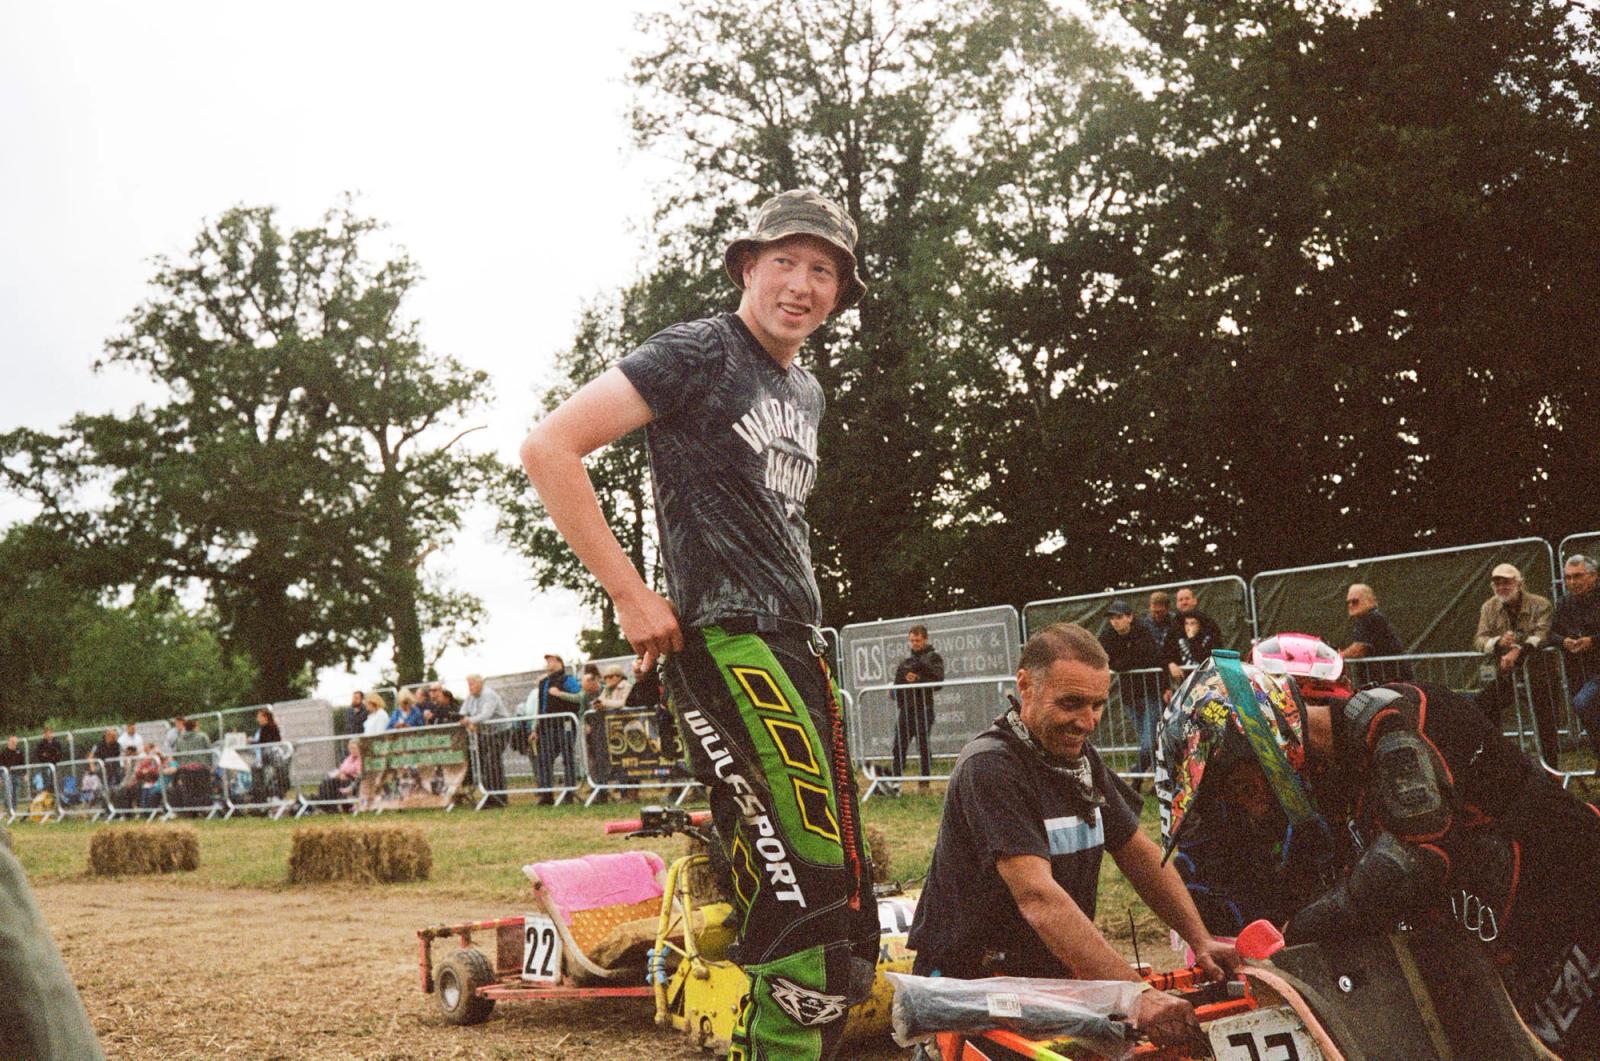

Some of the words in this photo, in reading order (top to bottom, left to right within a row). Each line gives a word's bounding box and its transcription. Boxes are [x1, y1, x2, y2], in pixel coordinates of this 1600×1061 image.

[855, 645, 882, 681] CLS
[684, 710, 807, 908] WULFSPORT
[525, 927, 555, 976] 22
